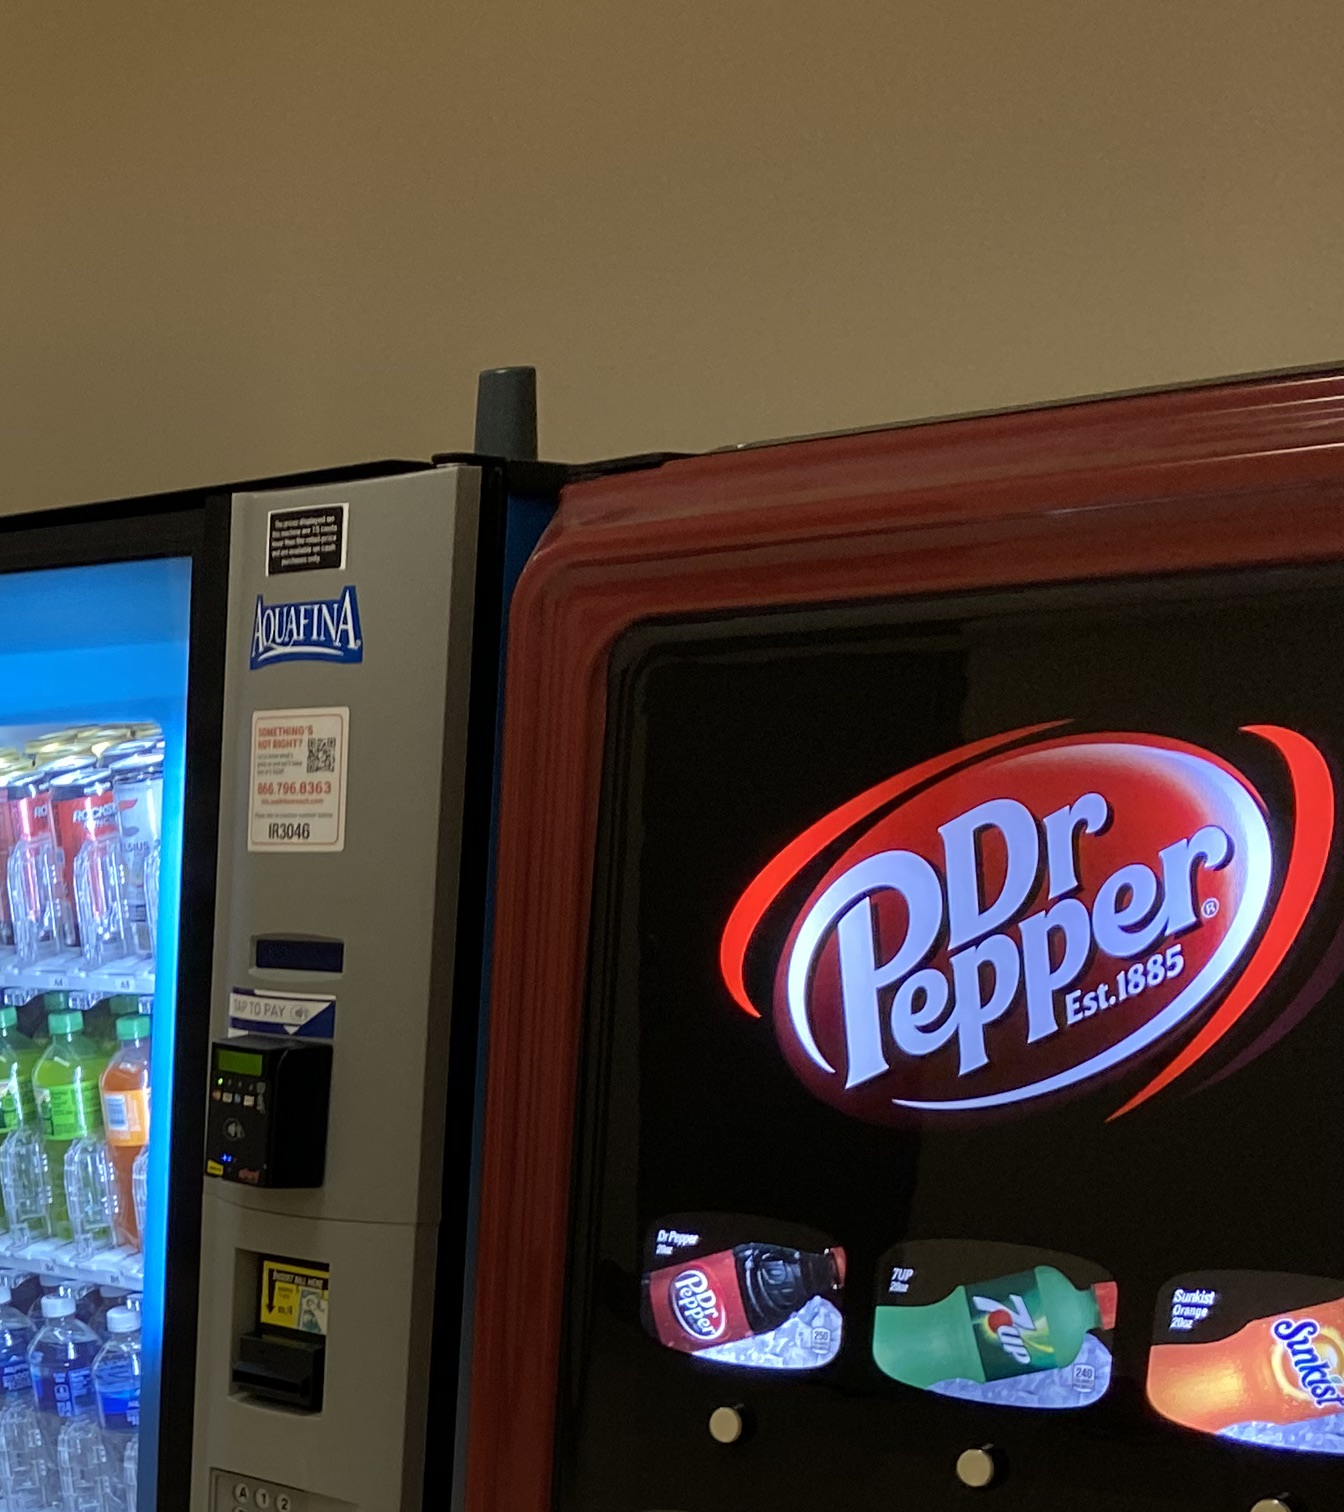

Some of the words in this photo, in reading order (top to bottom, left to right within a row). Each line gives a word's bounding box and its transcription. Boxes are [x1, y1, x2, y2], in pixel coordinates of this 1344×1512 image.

[252, 589, 355, 657] AQUAFINA
[257, 781, 332, 795] 866.796.8363
[268, 822, 310, 839] IR3046
[937, 793, 1111, 950] Dr
[788, 824, 1234, 1089] Pepper
[250, 1001, 261, 1016] TO
[264, 1003, 285, 1018] PAY
[669, 1230, 700, 1245] Pepper
[892, 1267, 914, 1280] 7UP
[675, 1270, 715, 1335] Pepper
[703, 1286, 719, 1318] Dr
[1173, 1288, 1216, 1305] Sunkist
[1172, 1305, 1208, 1319] Orange
[1170, 1317, 1193, 1330] 20oz
[814, 1330, 828, 1341] 250
[1271, 1319, 1344, 1406] Sunkist
[1075, 1367, 1092, 1379] 240
